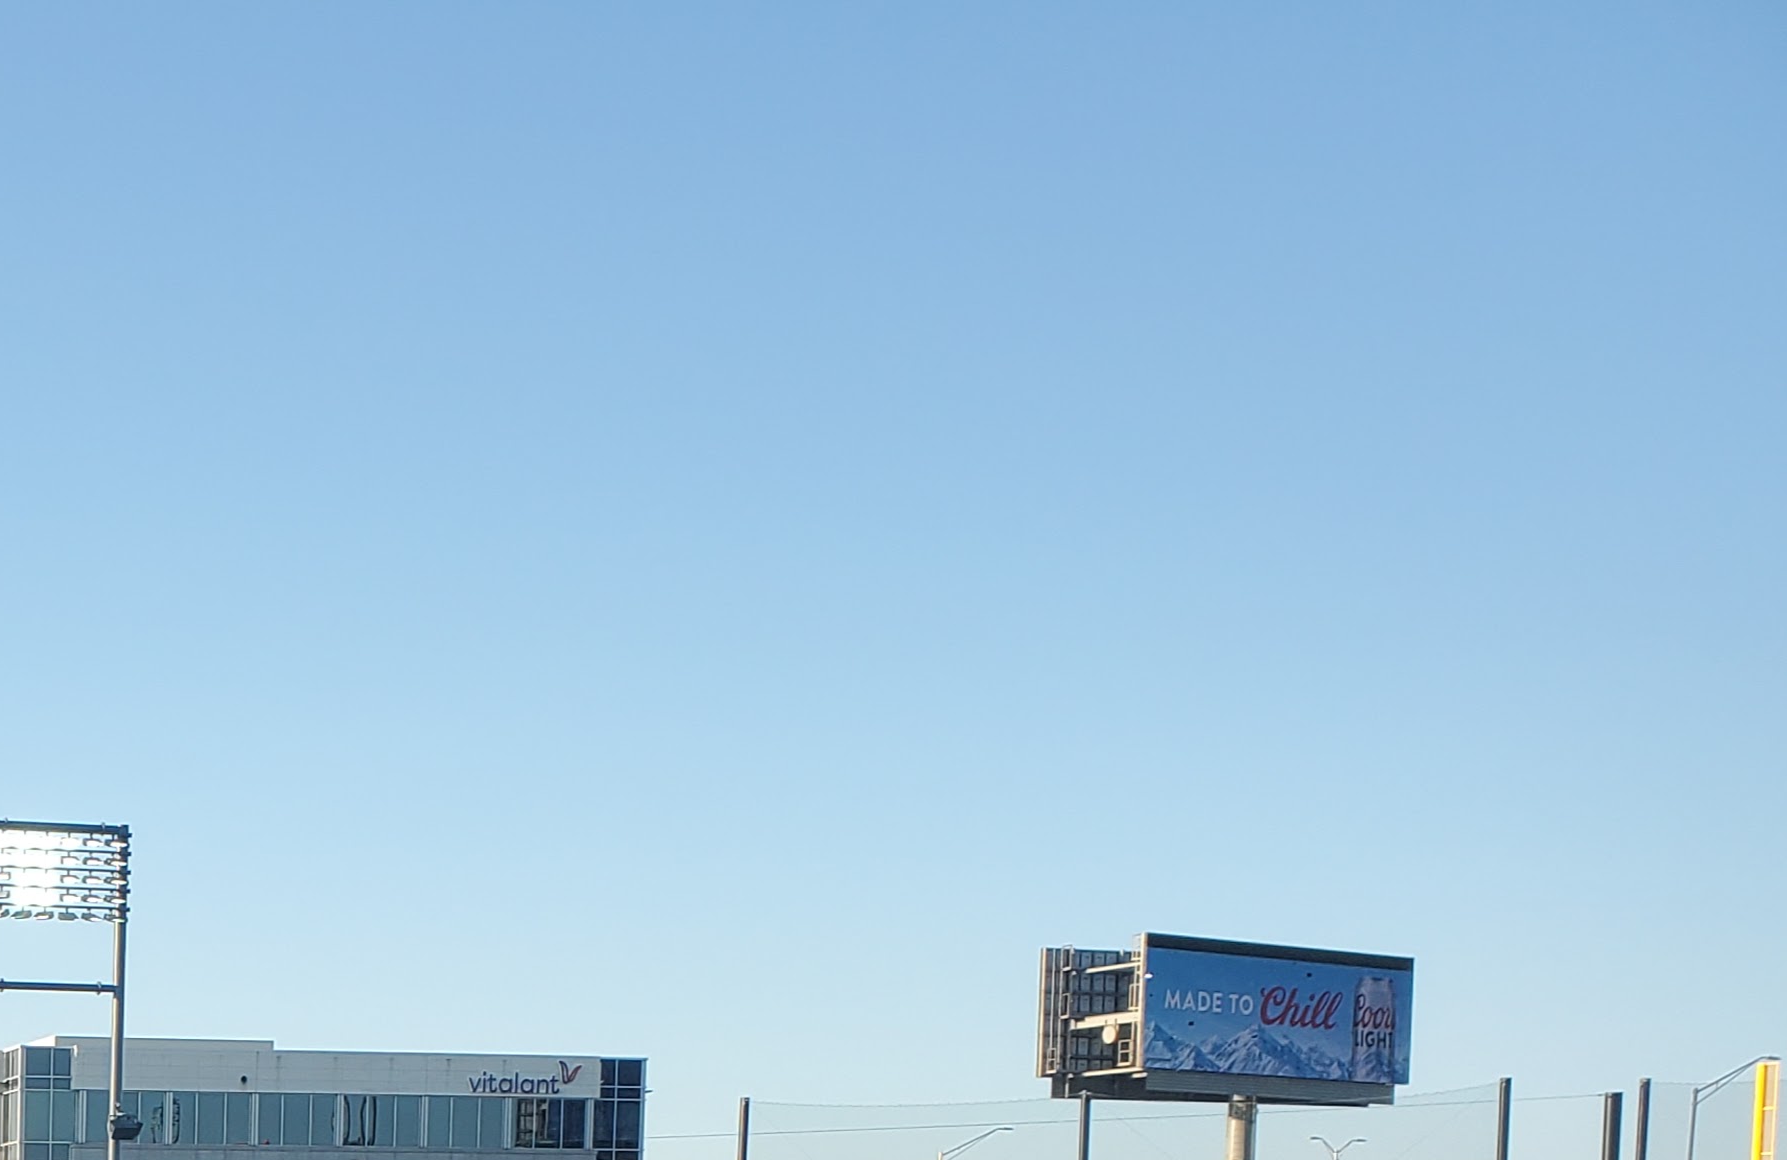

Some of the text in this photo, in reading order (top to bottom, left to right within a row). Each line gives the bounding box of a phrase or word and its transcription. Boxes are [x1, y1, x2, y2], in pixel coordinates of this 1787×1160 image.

[1164, 986, 1343, 1030] MADE TO Chill
[1355, 1030, 1393, 1048] LIGHT
[468, 1071, 560, 1094] vitalant
